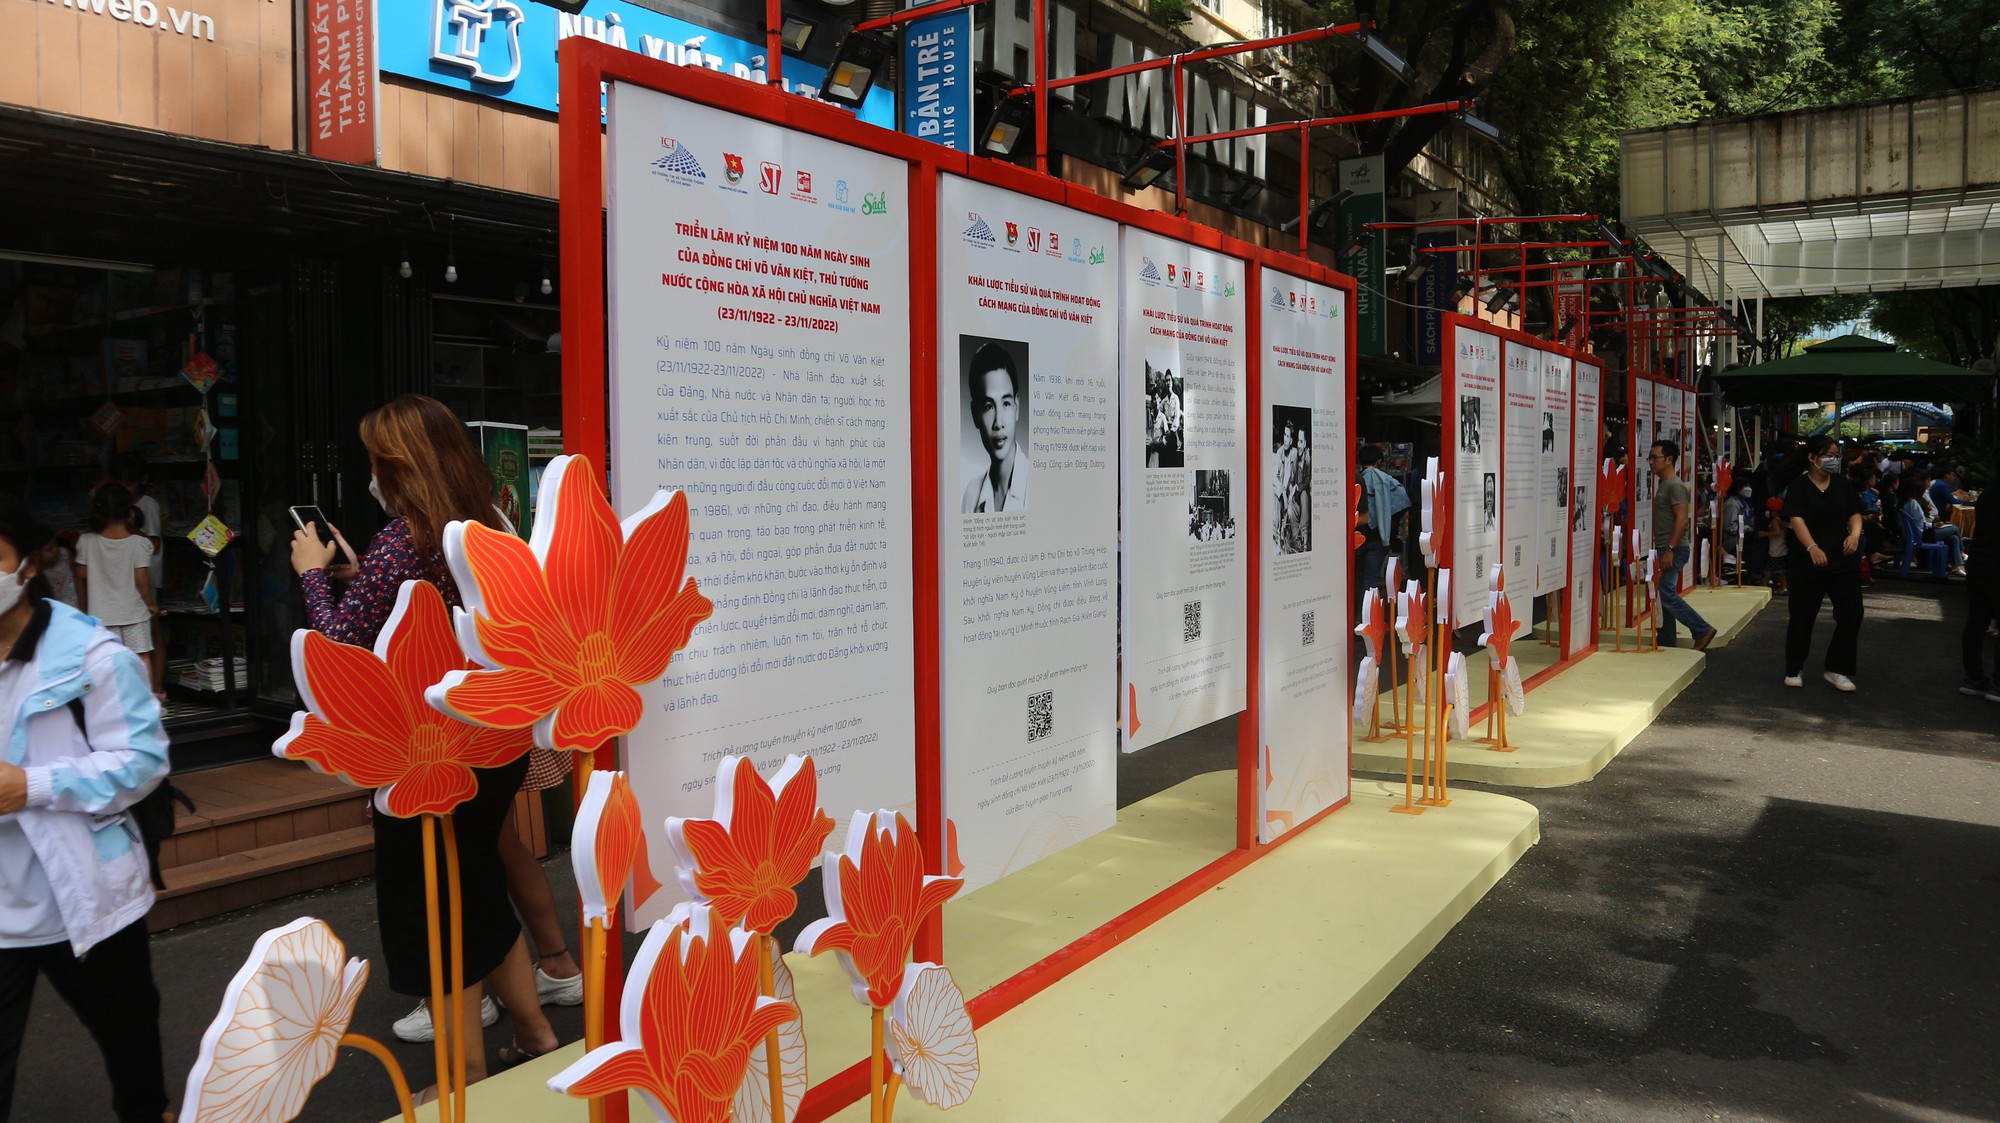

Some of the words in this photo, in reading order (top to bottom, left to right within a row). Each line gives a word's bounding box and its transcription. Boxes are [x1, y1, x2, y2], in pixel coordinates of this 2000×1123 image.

[336, 0, 350, 23] P
[312, 2, 330, 75] XUẤT
[356, 24, 364, 67] MINH
[911, 31, 940, 81] TRẺ
[943, 26, 955, 87] HOUSE
[335, 30, 352, 133] THÀNH
[357, 70, 365, 96] CHI
[316, 79, 332, 140] NHÀ
[910, 83, 940, 137] BẢN
[661, 136, 676, 148] ICT
[758, 160, 782, 196] ST
[861, 191, 887, 215] Sách
[675, 219, 708, 239] TRIỂN
[711, 227, 733, 244] LÃM
[736, 231, 751, 246] KỶ
[753, 236, 778, 253] NIỆM
[780, 242, 798, 255] 100
[800, 244, 822, 259] NĂM
[824, 249, 848, 264] NGÀY
[849, 255, 870, 268] SINH
[1026, 226, 1041, 253] ST
[678, 246, 700, 264] CỦA
[702, 249, 732, 269] ĐỒNG
[735, 258, 752, 272] CHÍ
[754, 260, 768, 274] VÕ
[770, 263, 790, 278] VĂN
[793, 267, 817, 284] KIỆT,
[819, 271, 837, 285] THỦ
[839, 275, 868, 290] TƯỚNG
[662, 273, 692, 289] NƯỚC
[695, 276, 724, 294] CỘNG
[727, 281, 749, 296] HÒA
[751, 284, 766, 298] XÃ
[768, 287, 785, 303] HỘI
[788, 289, 806, 304] CHỦ
[809, 294, 838, 308] NGHĨA
[839, 297, 859, 313] VIỆT
[861, 302, 880, 314] NAM
[968, 275, 985, 287] KHÁI
[986, 278, 1003, 292] LƯỢC
[1004, 278, 1019, 293] TIỂU
[1020, 283, 1029, 295] SỬ
[1029, 285, 1038, 296] VÀ
[1039, 288, 1051, 299] QUÁ
[1052, 290, 1069, 302] TRÌNH
[1070, 294, 1085, 306] HOẠT
[1085, 296, 1100, 308] ĐỘNG
[718, 306, 775, 324] (23/11/1922
[785, 315, 838, 333] 23/11/2022)
[978, 296, 996, 309] CÁCH
[997, 300, 1017, 313] MẠNG
[1018, 301, 1030, 314] CỦA
[1031, 303, 1048, 317] ĐỒNG
[1049, 308, 1059, 319] CHÍ
[1059, 309, 1067, 320] VÕ
[1068, 311, 1079, 322] VĂN
[1080, 313, 1093, 326] KIỆT
[656, 335, 669, 350] Kỷ
[675, 337, 698, 351] niệm
[703, 340, 721, 352] 100
[726, 342, 746, 354] năm
[750, 344, 773, 359] Ngày
[778, 347, 795, 358] sinh
[799, 347, 820, 363] đồng
[824, 351, 835, 362] chí
[838, 353, 849, 363] Võ
[852, 354, 867, 364] Văn
[870, 356, 885, 368] Kiệt
[656, 360, 765, 380] (23/11/1922-23/11/2022)
[783, 370, 799, 381] Nhà
[806, 371, 823, 382] lãnh
[830, 373, 844, 384] đạo
[851, 373, 867, 385] xuất
[873, 374, 885, 387] sắc
[657, 384, 674, 397] của
[679, 385, 706, 401] Đảng,
[711, 388, 730, 399] Nhà
[735, 389, 756, 400] nước
[760, 390, 771, 401] và
[775, 391, 797, 402] Nhân
[801, 392, 816, 403] dân
[820, 395, 830, 405] ta;
[834, 395, 855, 407] người
[858, 395, 871, 408] học
[875, 397, 885, 407] trò
